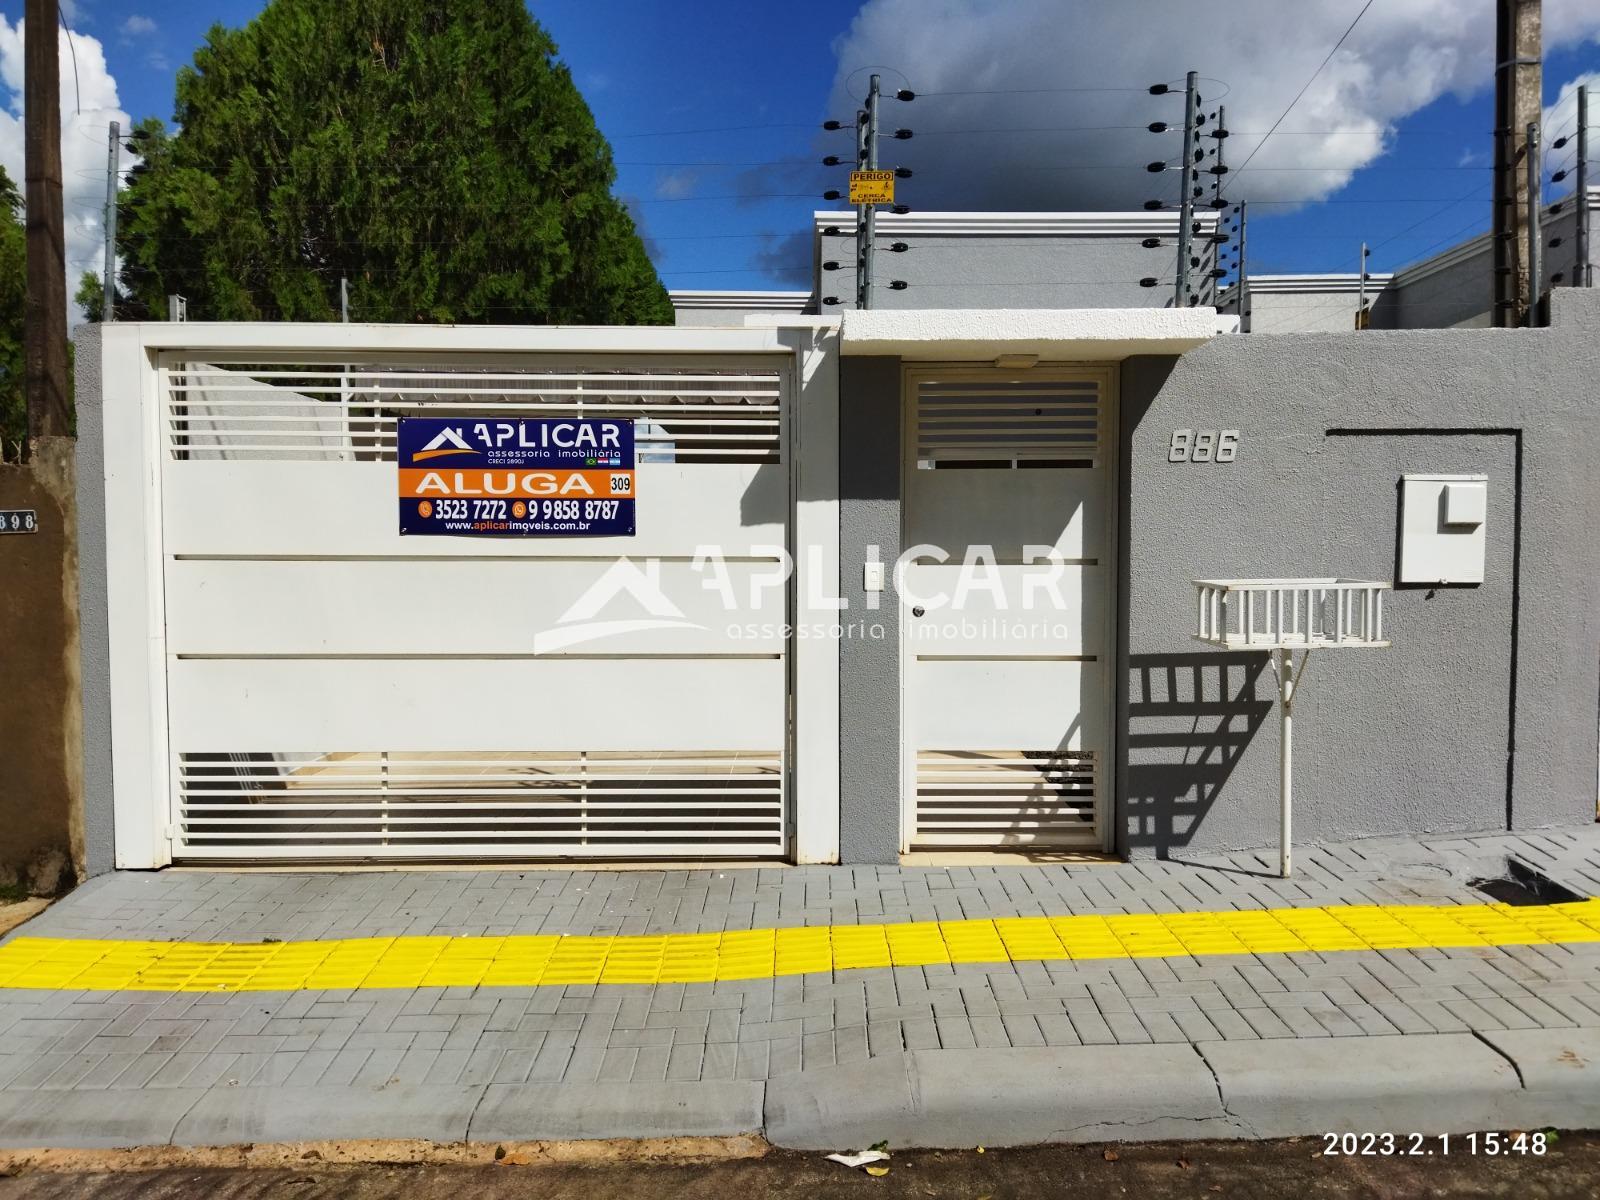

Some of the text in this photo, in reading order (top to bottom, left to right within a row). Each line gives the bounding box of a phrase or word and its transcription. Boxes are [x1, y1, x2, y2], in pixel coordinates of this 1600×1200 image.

[473, 423, 620, 448] APLICAR
[487, 450, 550, 458] assessoria
[1167, 429, 1240, 463] 886
[415, 472, 595, 495] ALUGA
[611, 477, 631, 491] 309
[435, 500, 619, 520] 3523 7272 9 9858 8787
[445, 521, 591, 531] www.aplicarimoveis.com.br
